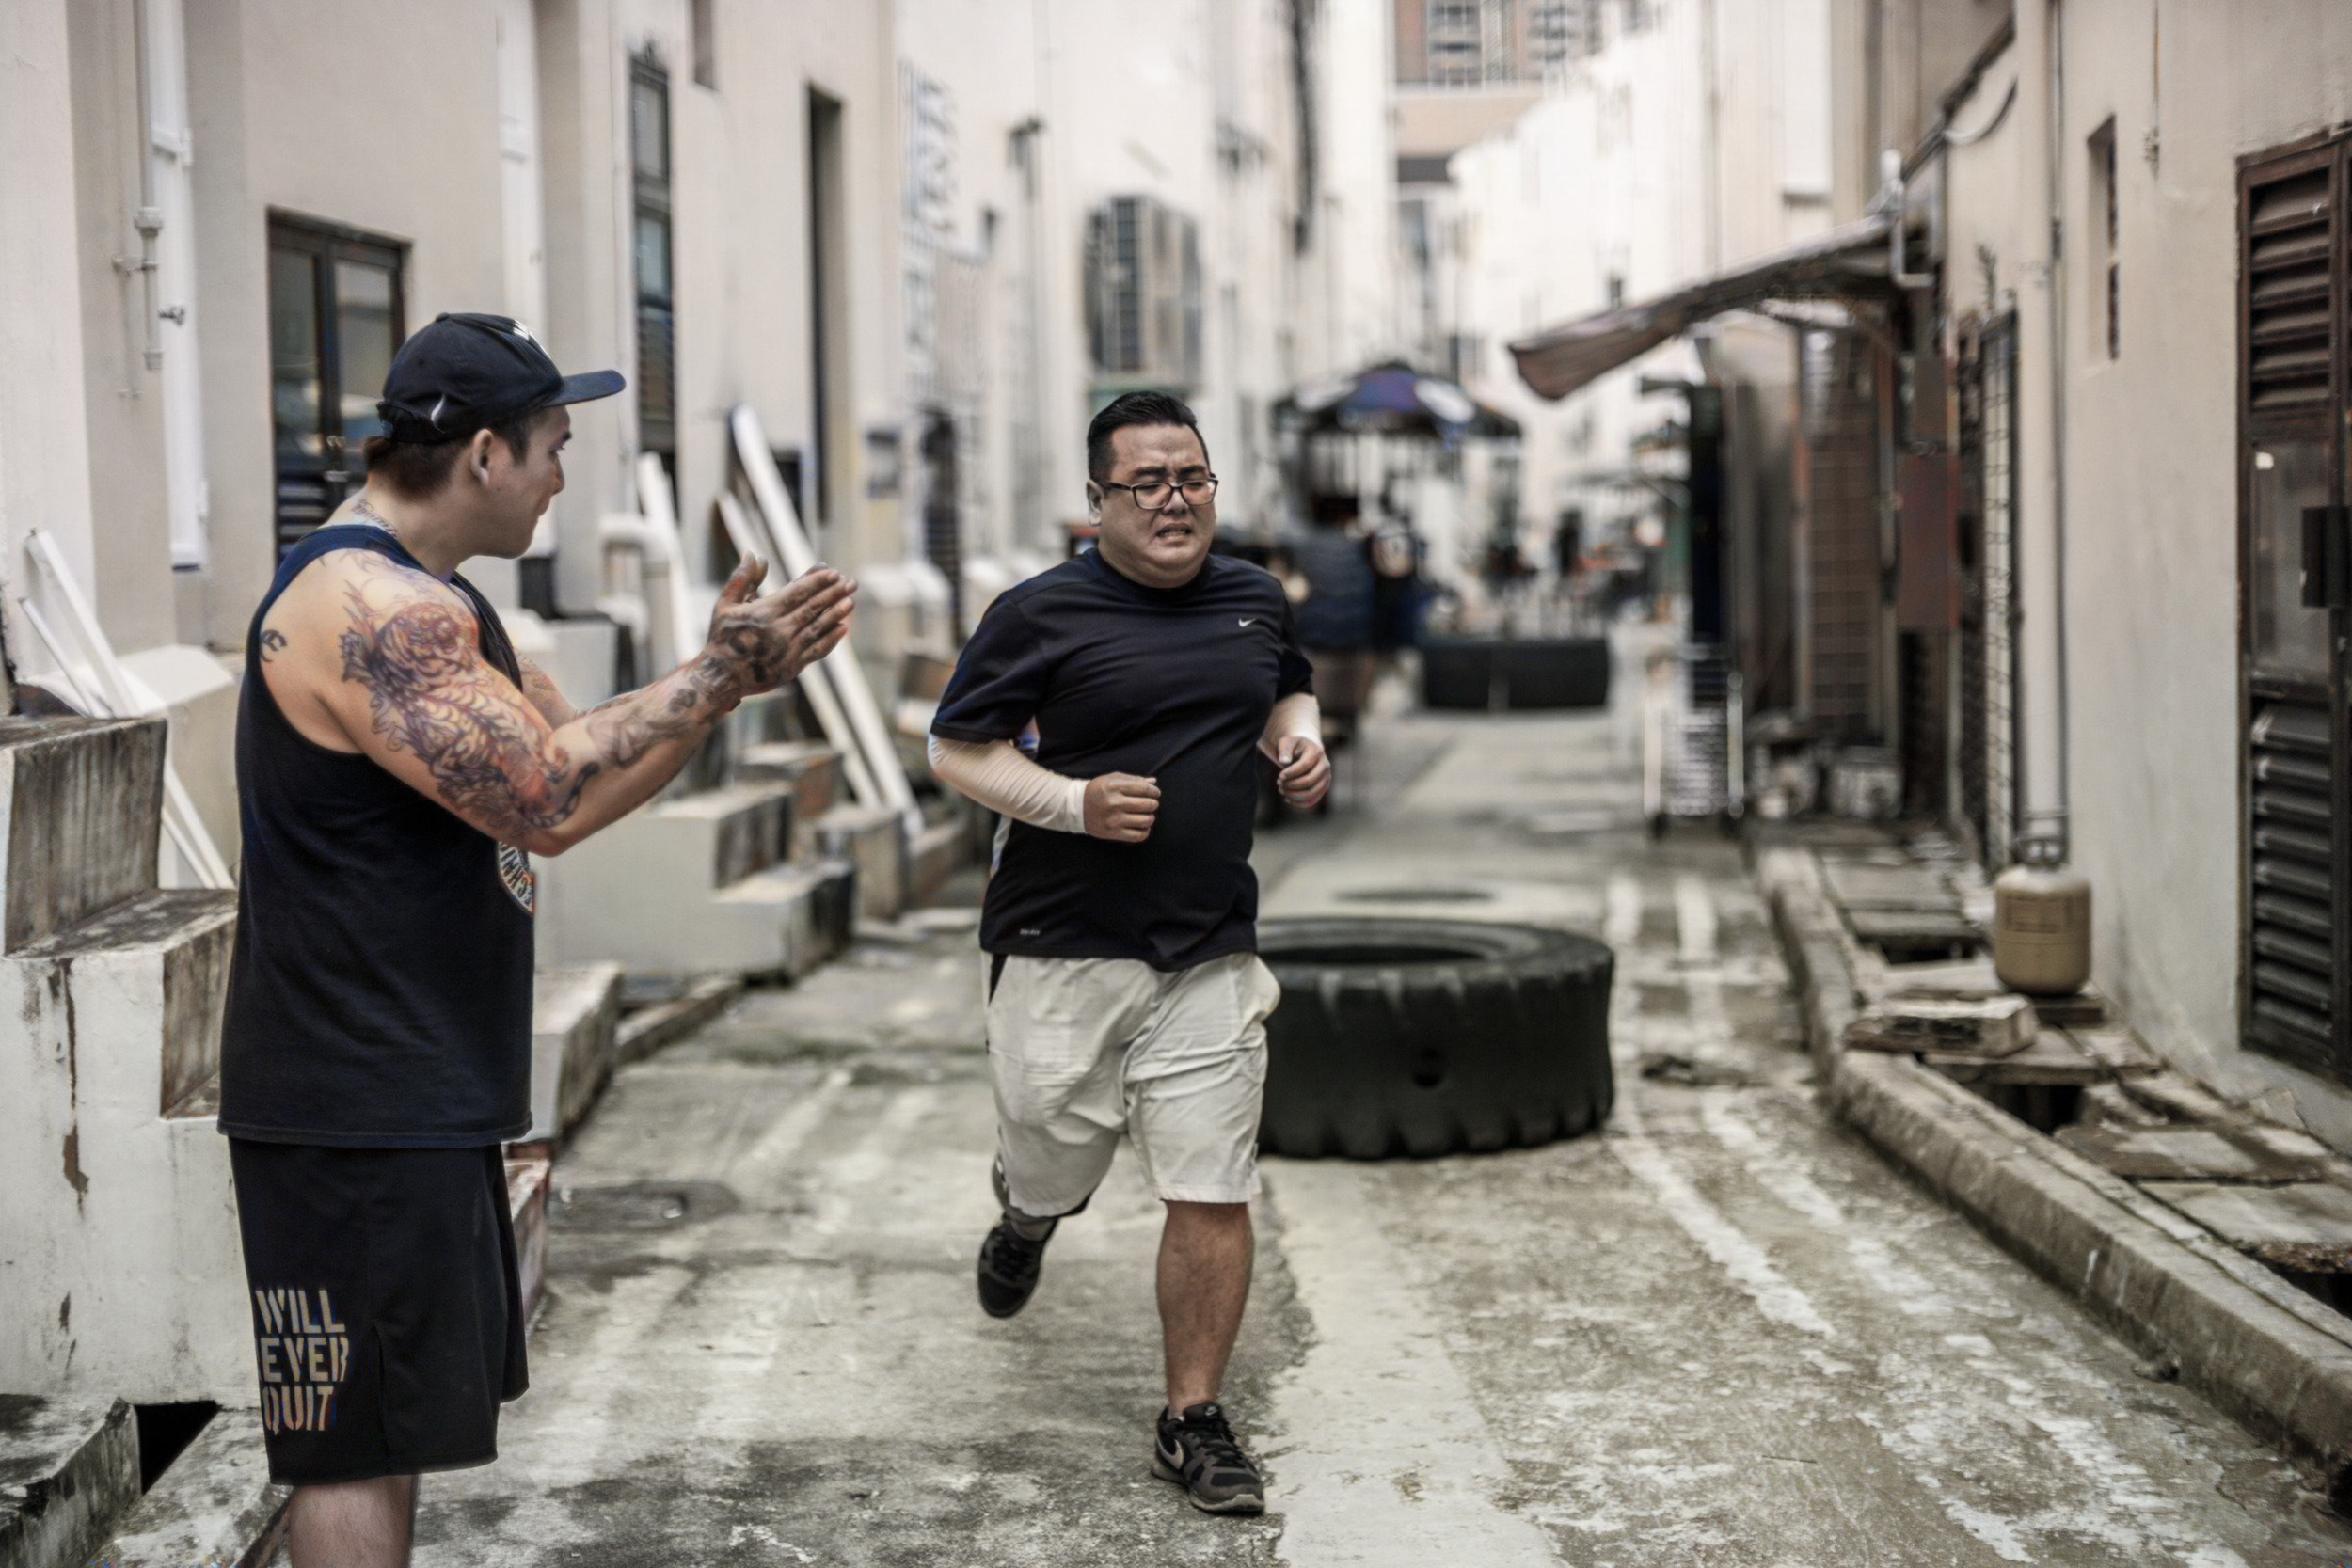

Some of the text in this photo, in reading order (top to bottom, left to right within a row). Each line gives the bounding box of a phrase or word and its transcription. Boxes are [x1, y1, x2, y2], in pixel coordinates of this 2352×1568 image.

[255, 1290, 345, 1334] WILL
[258, 1337, 349, 1383] EVER
[262, 1386, 333, 1435] QUIT
